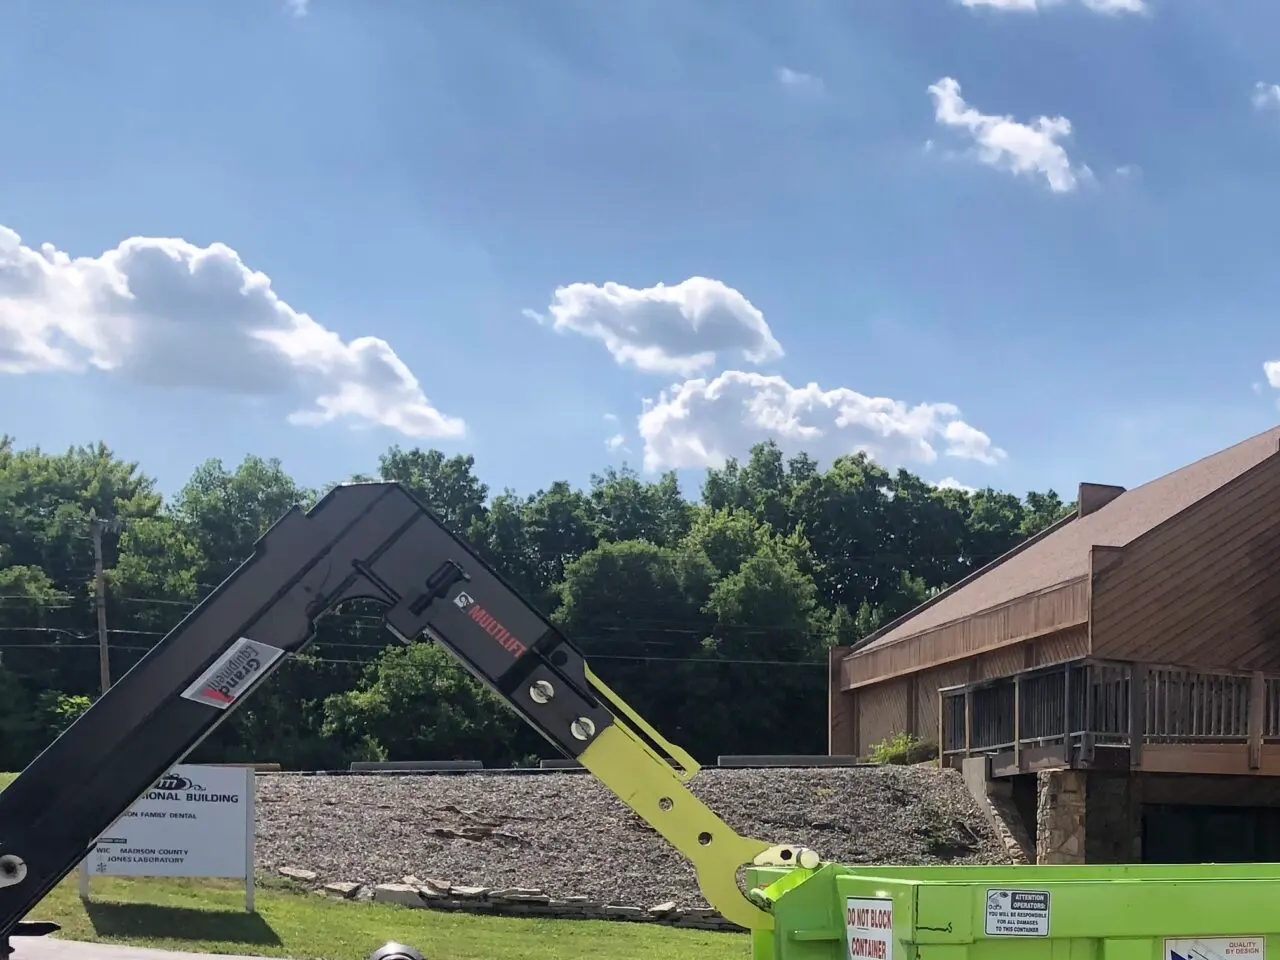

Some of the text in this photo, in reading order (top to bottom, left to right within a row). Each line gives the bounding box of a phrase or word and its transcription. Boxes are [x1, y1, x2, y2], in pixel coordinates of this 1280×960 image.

[468, 605, 527, 658] MULTILIFT
[207, 646, 258, 692] Equipment
[217, 658, 261, 698] Grand
[186, 793, 239, 803] BUILDING
[169, 812, 197, 820] DENTAL
[133, 856, 185, 864] LABORATORY
[847, 907, 892, 930] DO NOT BLOCK
[851, 937, 887, 960] CONTAINER
